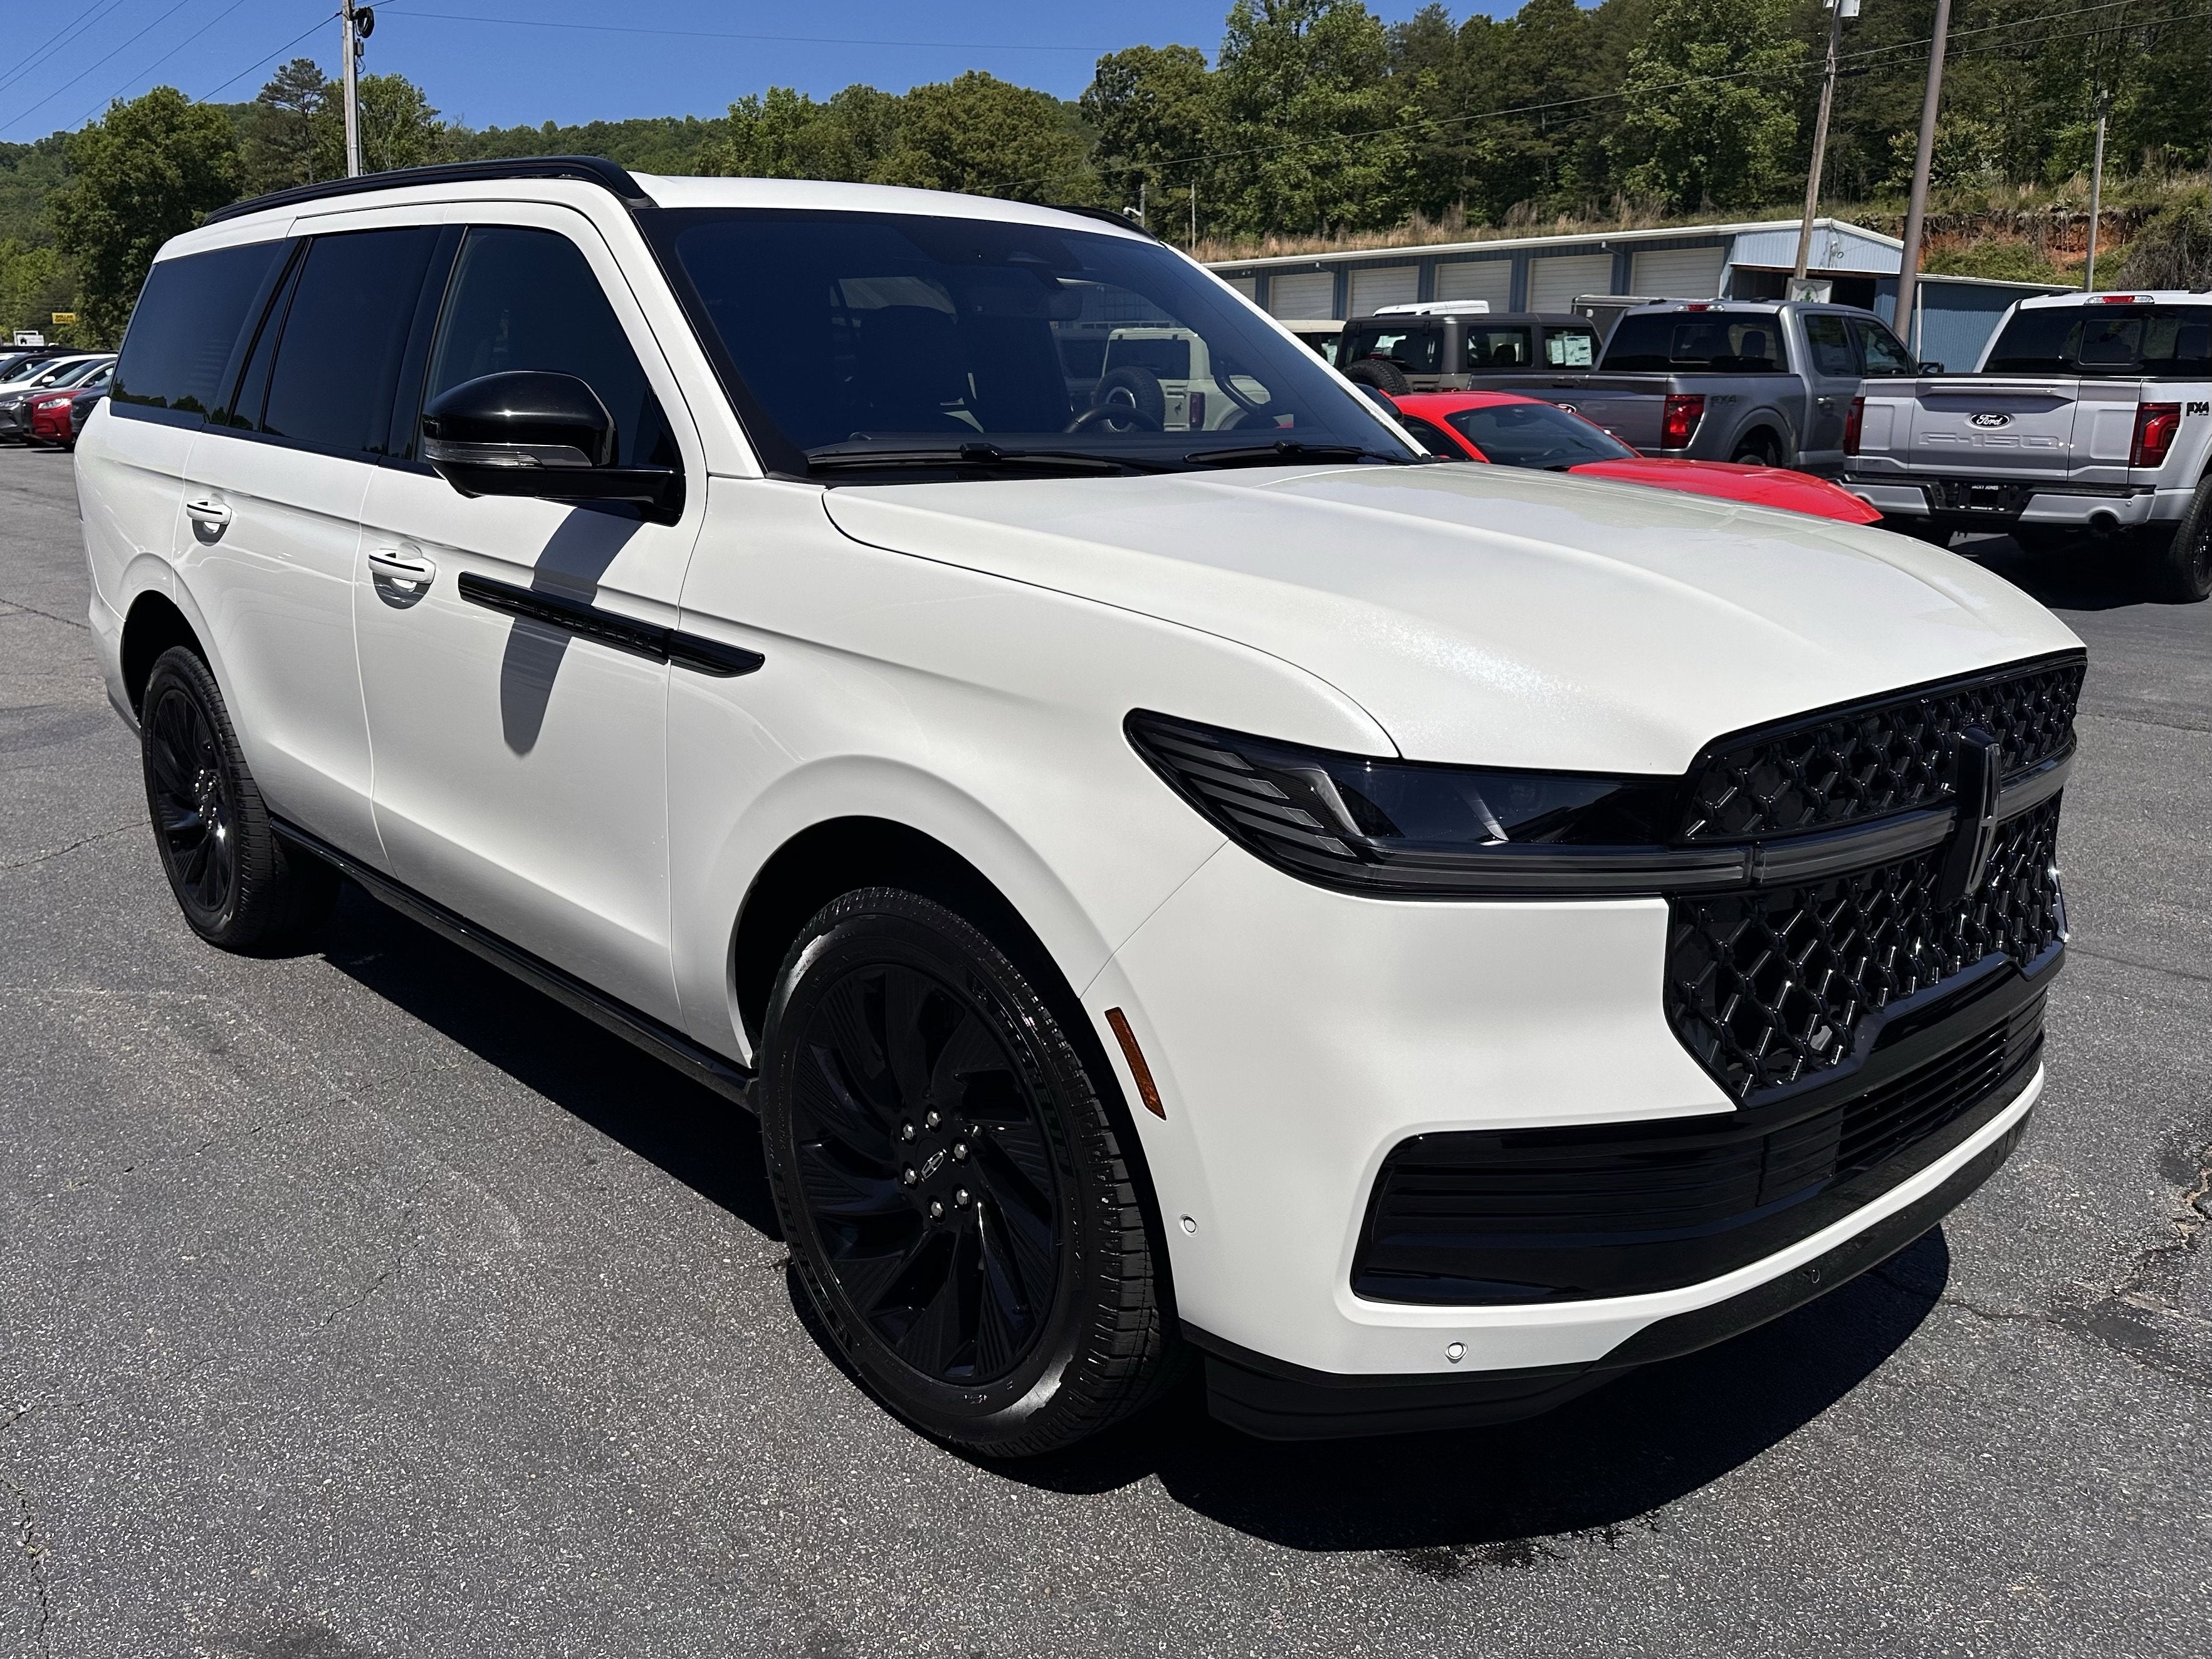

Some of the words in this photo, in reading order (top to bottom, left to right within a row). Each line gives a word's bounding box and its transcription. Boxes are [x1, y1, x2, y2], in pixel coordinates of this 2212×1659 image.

[1710, 394, 1736, 407] FX4
[2186, 402, 2209, 416] FX4
[1976, 414, 2002, 426] Ford
[1919, 432, 2059, 449] F-150
